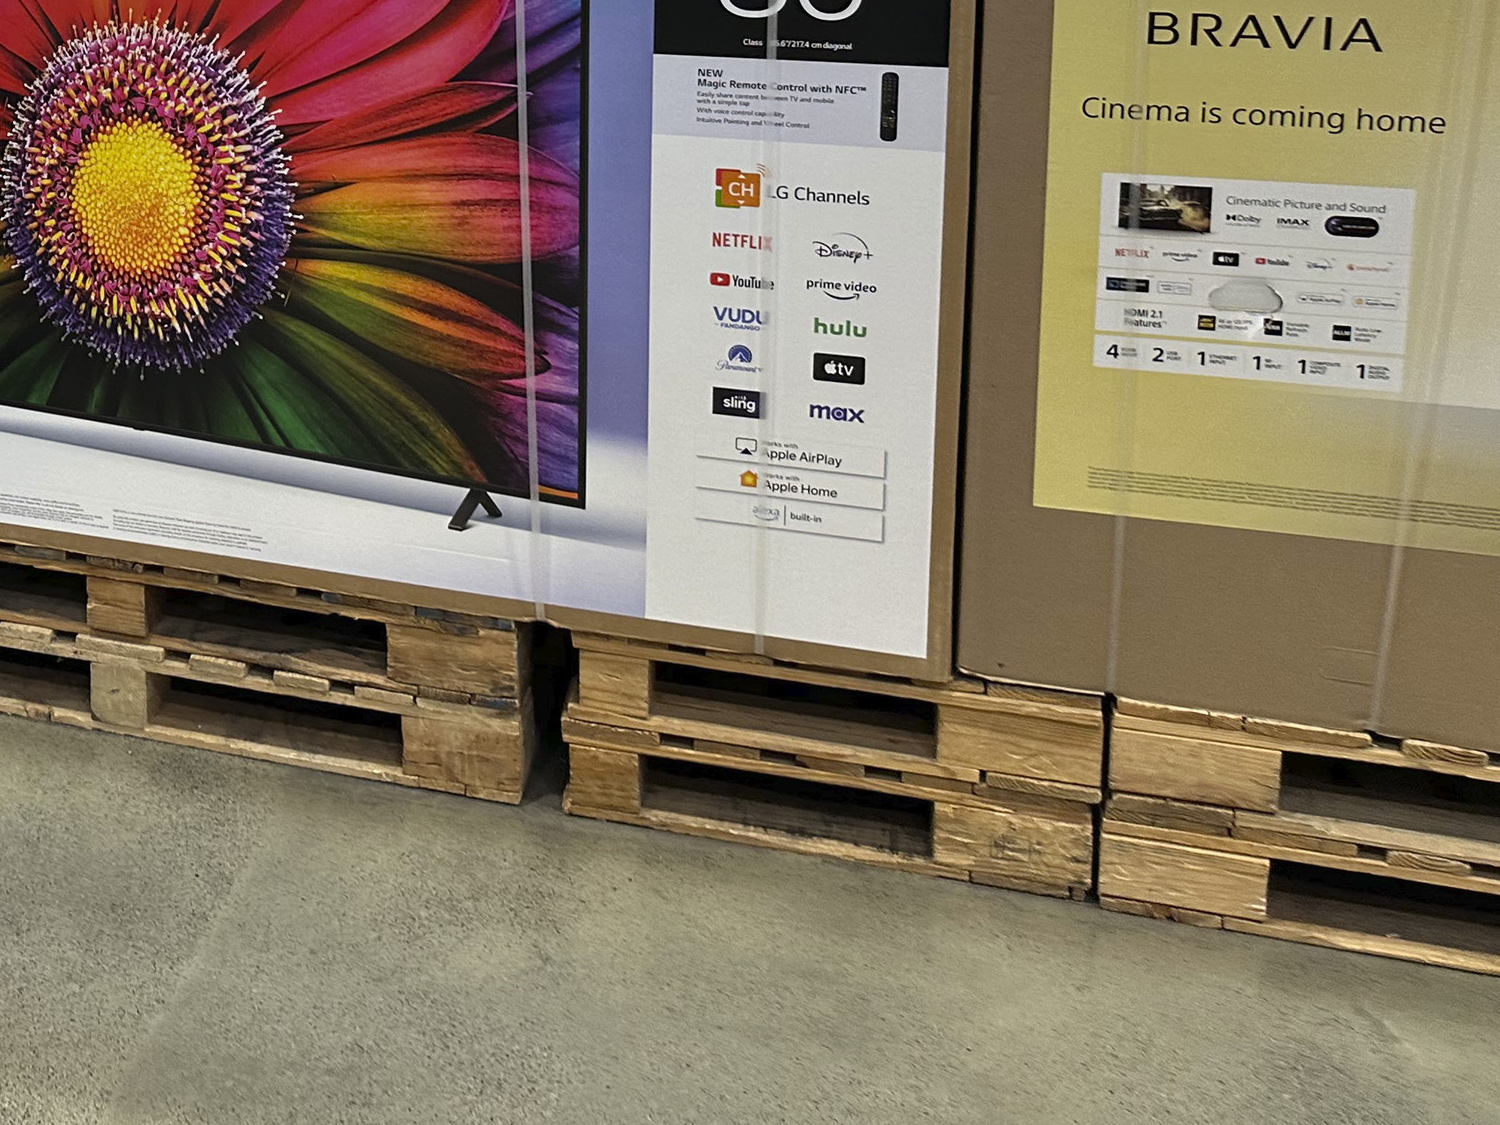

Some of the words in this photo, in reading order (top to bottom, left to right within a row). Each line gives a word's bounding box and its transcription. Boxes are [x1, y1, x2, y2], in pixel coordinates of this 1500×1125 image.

[1146, 11, 1384, 53] BRAVIA
[697, 68, 723, 78] NEW
[697, 78, 727, 90] Magic
[730, 80, 767, 90] Remote
[810, 84, 832, 93] with
[1081, 96, 1190, 123] Cinema
[1200, 101, 1222, 124] is
[1232, 106, 1345, 135] coming
[1356, 108, 1447, 135] home
[728, 181, 754, 197] CH
[794, 187, 870, 206] Channels
[1226, 195, 1281, 209] Cinematic
[1283, 198, 1323, 211] Picture
[1325, 201, 1347, 213] and
[1349, 203, 1387, 215] Sound
[1276, 217, 1311, 227] IMAX
[712, 231, 774, 253] NETFLIX
[806, 279, 842, 292] prime
[843, 283, 878, 294] video
[814, 317, 868, 338] hulu
[1106, 344, 1119, 359] 4
[1152, 347, 1164, 362] 2
[1197, 351, 1206, 366] 1
[1252, 355, 1261, 371] 1
[1297, 359, 1307, 375] 1
[1356, 363, 1366, 379] 1
[723, 396, 756, 413] sling
[809, 403, 865, 424] max
[799, 452, 843, 468] AirPlay
[801, 484, 839, 498] Home
[790, 511, 823, 524] built-in
